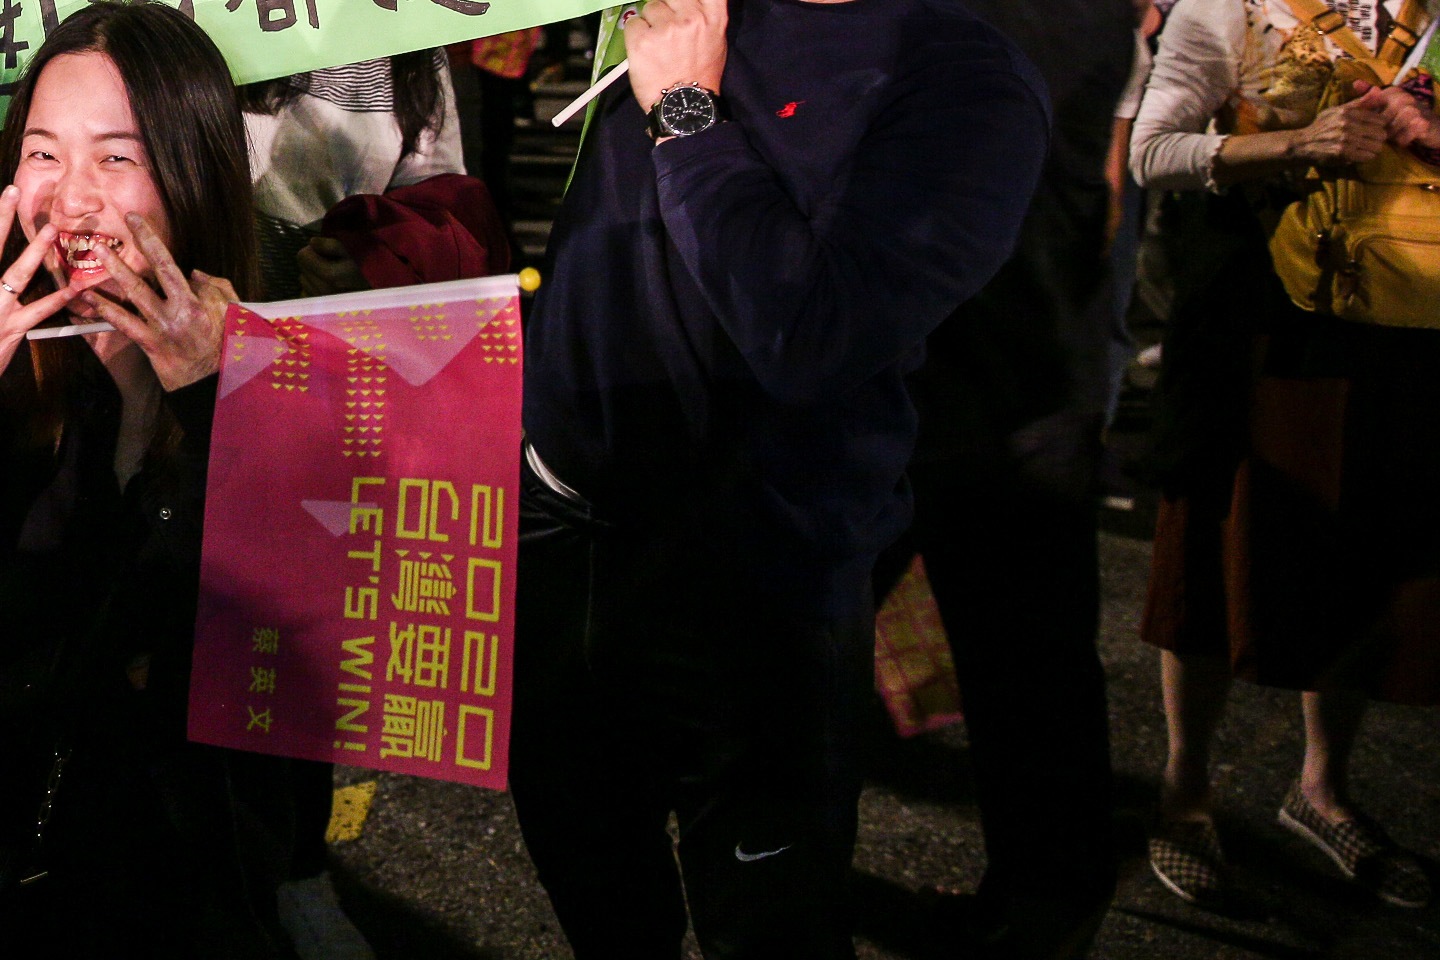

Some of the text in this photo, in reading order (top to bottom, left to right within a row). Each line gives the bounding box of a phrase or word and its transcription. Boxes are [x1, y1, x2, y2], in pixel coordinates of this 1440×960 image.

[246, 626, 280, 735] 蔡英文
[332, 476, 387, 753] LET'S WIN!
[379, 477, 461, 763] 台灣要贏
[454, 483, 505, 772] 2020
